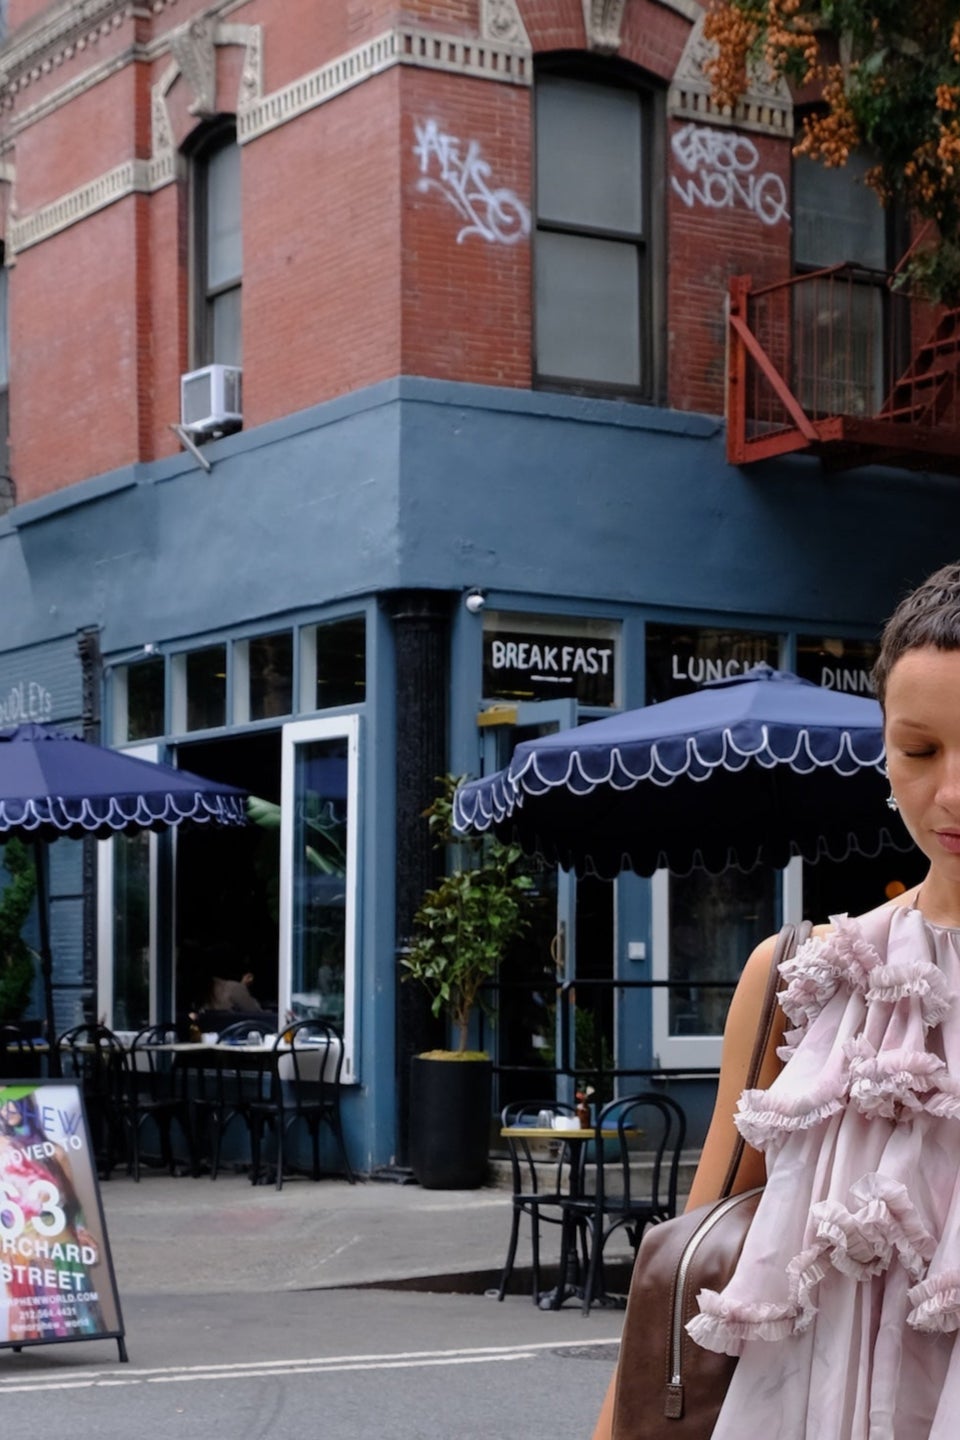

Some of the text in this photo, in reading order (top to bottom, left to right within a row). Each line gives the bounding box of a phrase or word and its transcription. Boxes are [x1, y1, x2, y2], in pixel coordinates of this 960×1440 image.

[492, 640, 612, 675] BREAKFAST
[59, 1135, 82, 1152] TO
[0, 1263, 85, 1291] STREET
